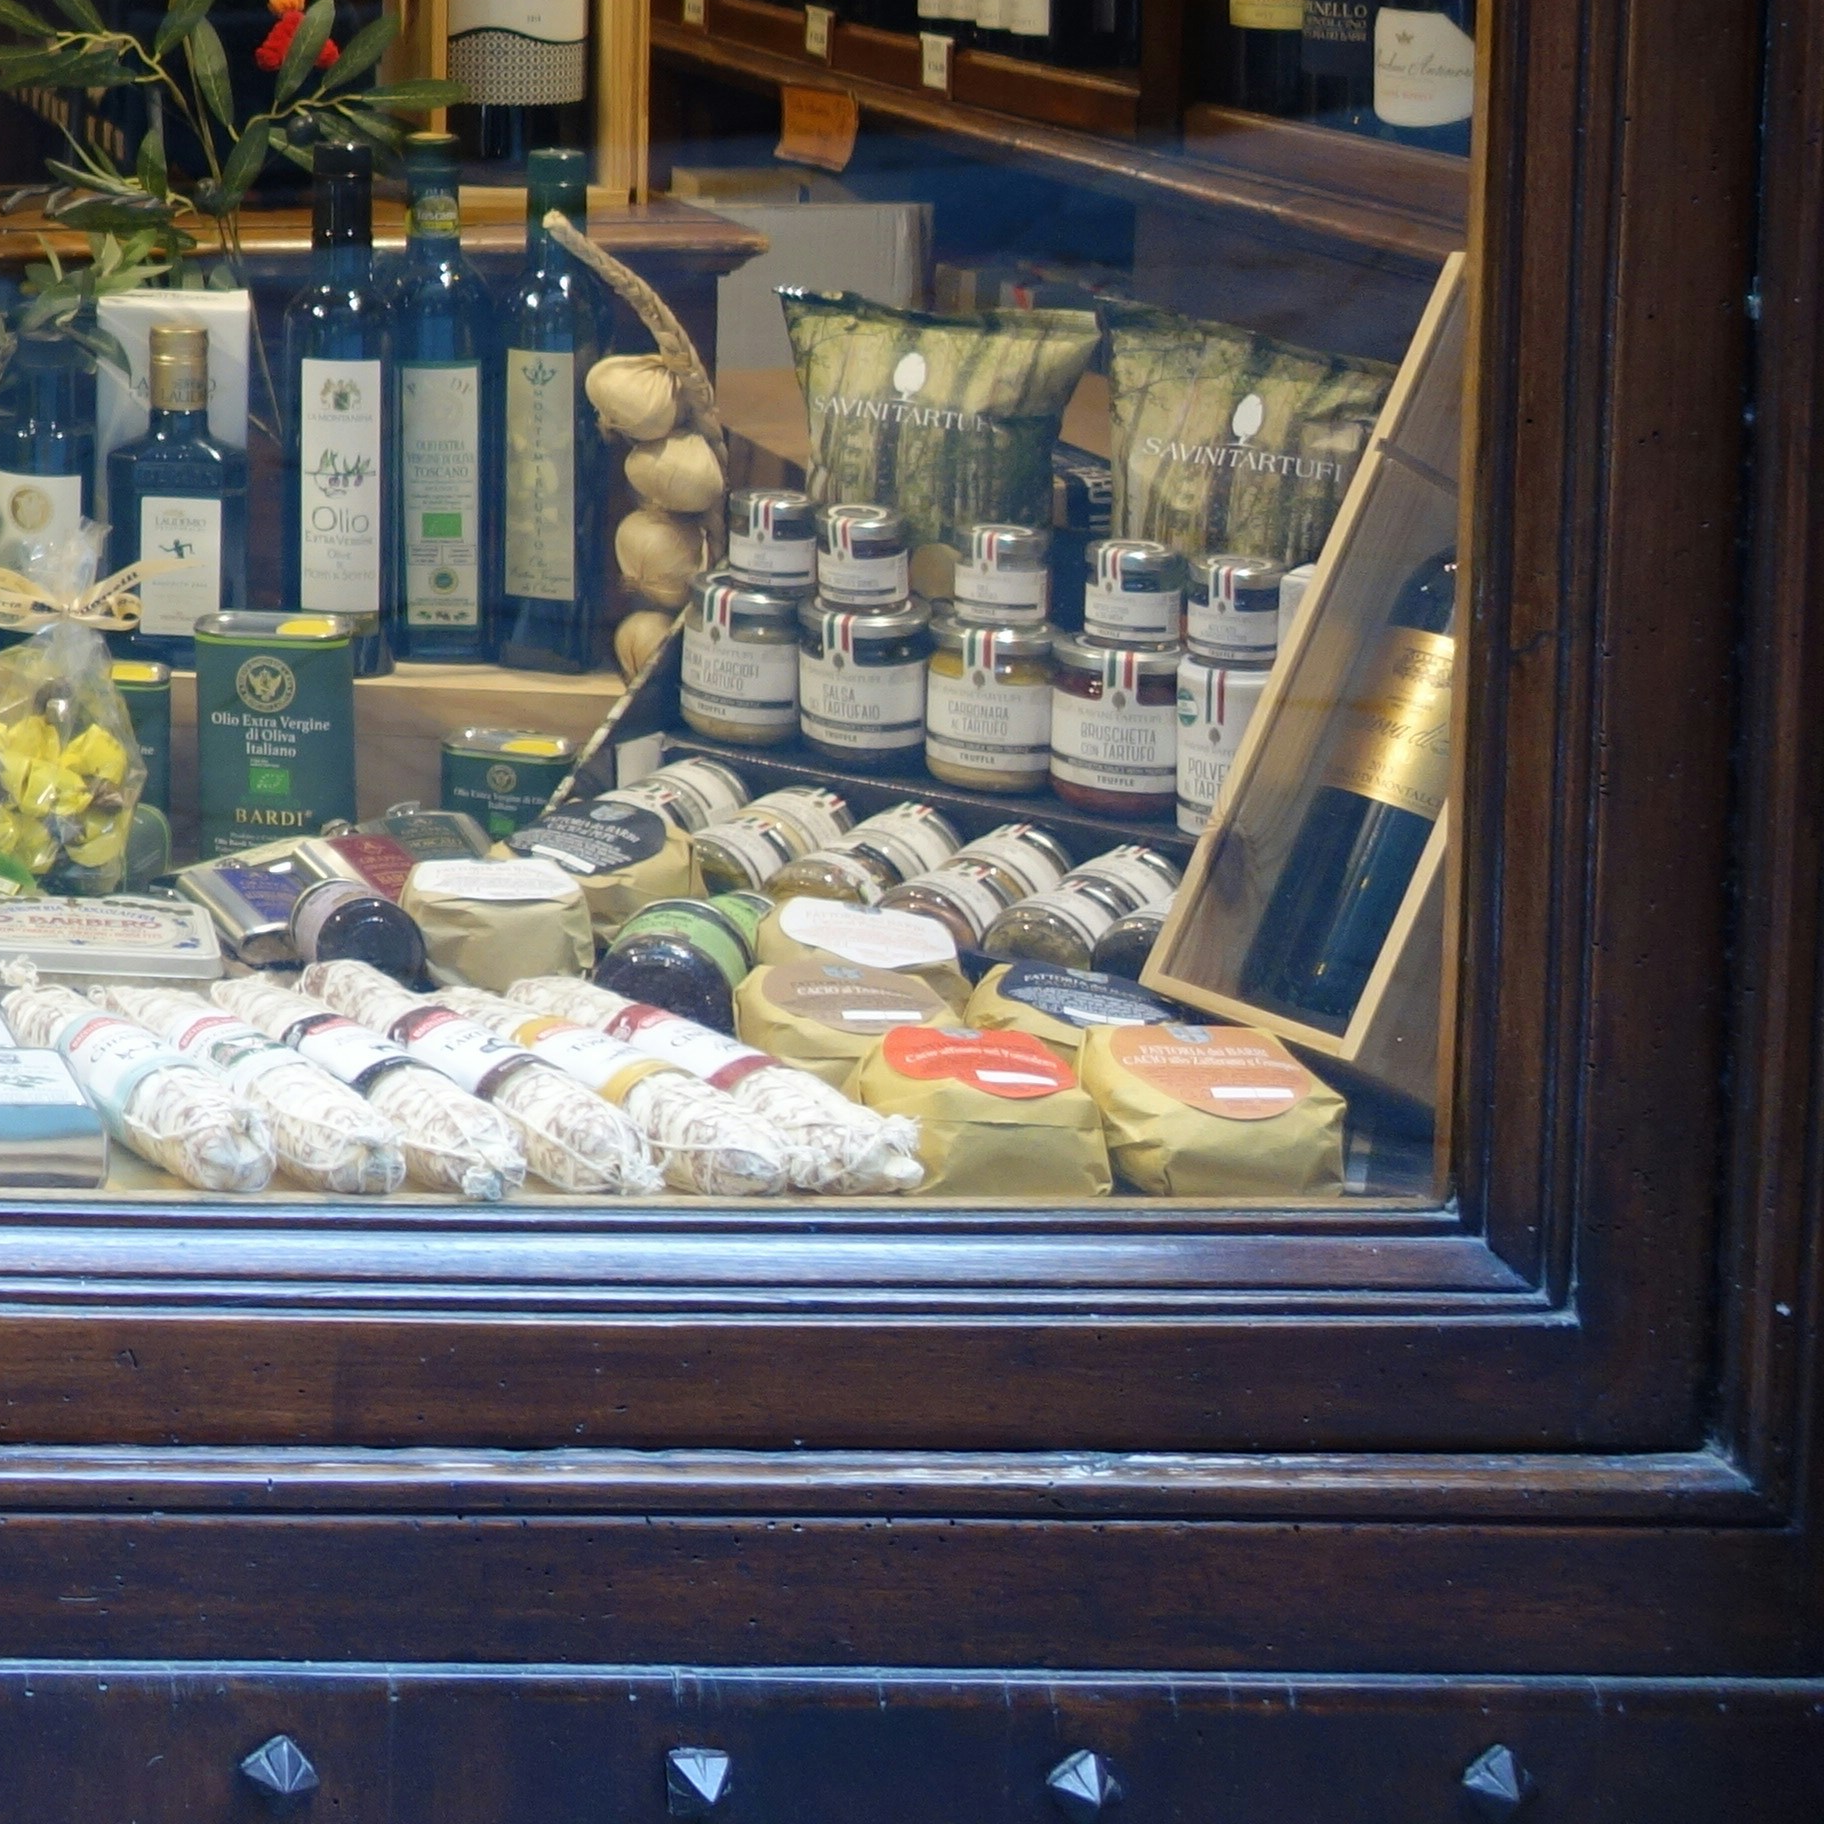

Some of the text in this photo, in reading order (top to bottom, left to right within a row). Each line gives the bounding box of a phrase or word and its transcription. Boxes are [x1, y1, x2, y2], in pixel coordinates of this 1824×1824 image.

[813, 393, 898, 423] SAVINI
[1141, 436, 1343, 483] SAVINI TARTUFI
[414, 466, 469, 478] TOSCANO
[312, 505, 370, 534] Olio
[713, 658, 760, 678] CARCIOFI
[702, 668, 744, 691] TARTUFO
[823, 683, 856, 702] SALSA
[823, 702, 880, 720] TARTUFAIO
[948, 699, 1010, 721] CARBONARA
[211, 711, 330, 734] Olio Extra Vergine
[962, 719, 1008, 736] TARTUFO
[245, 727, 296, 744] di Oliva
[824, 729, 858, 743] TRUFFLE
[1080, 721, 1157, 746] BRUSCHETTA
[245, 742, 297, 758] Italiano
[959, 751, 996, 765] TRUFFLE
[1080, 741, 1156, 762] CON TARTUFO
[1097, 774, 1135, 787] TRUFFLE
[18, 913, 162, 930] BARBERO
[1123, 1054, 1166, 1066] CACIO
[1139, 1044, 1268, 1059] FATTORIA BARBI
